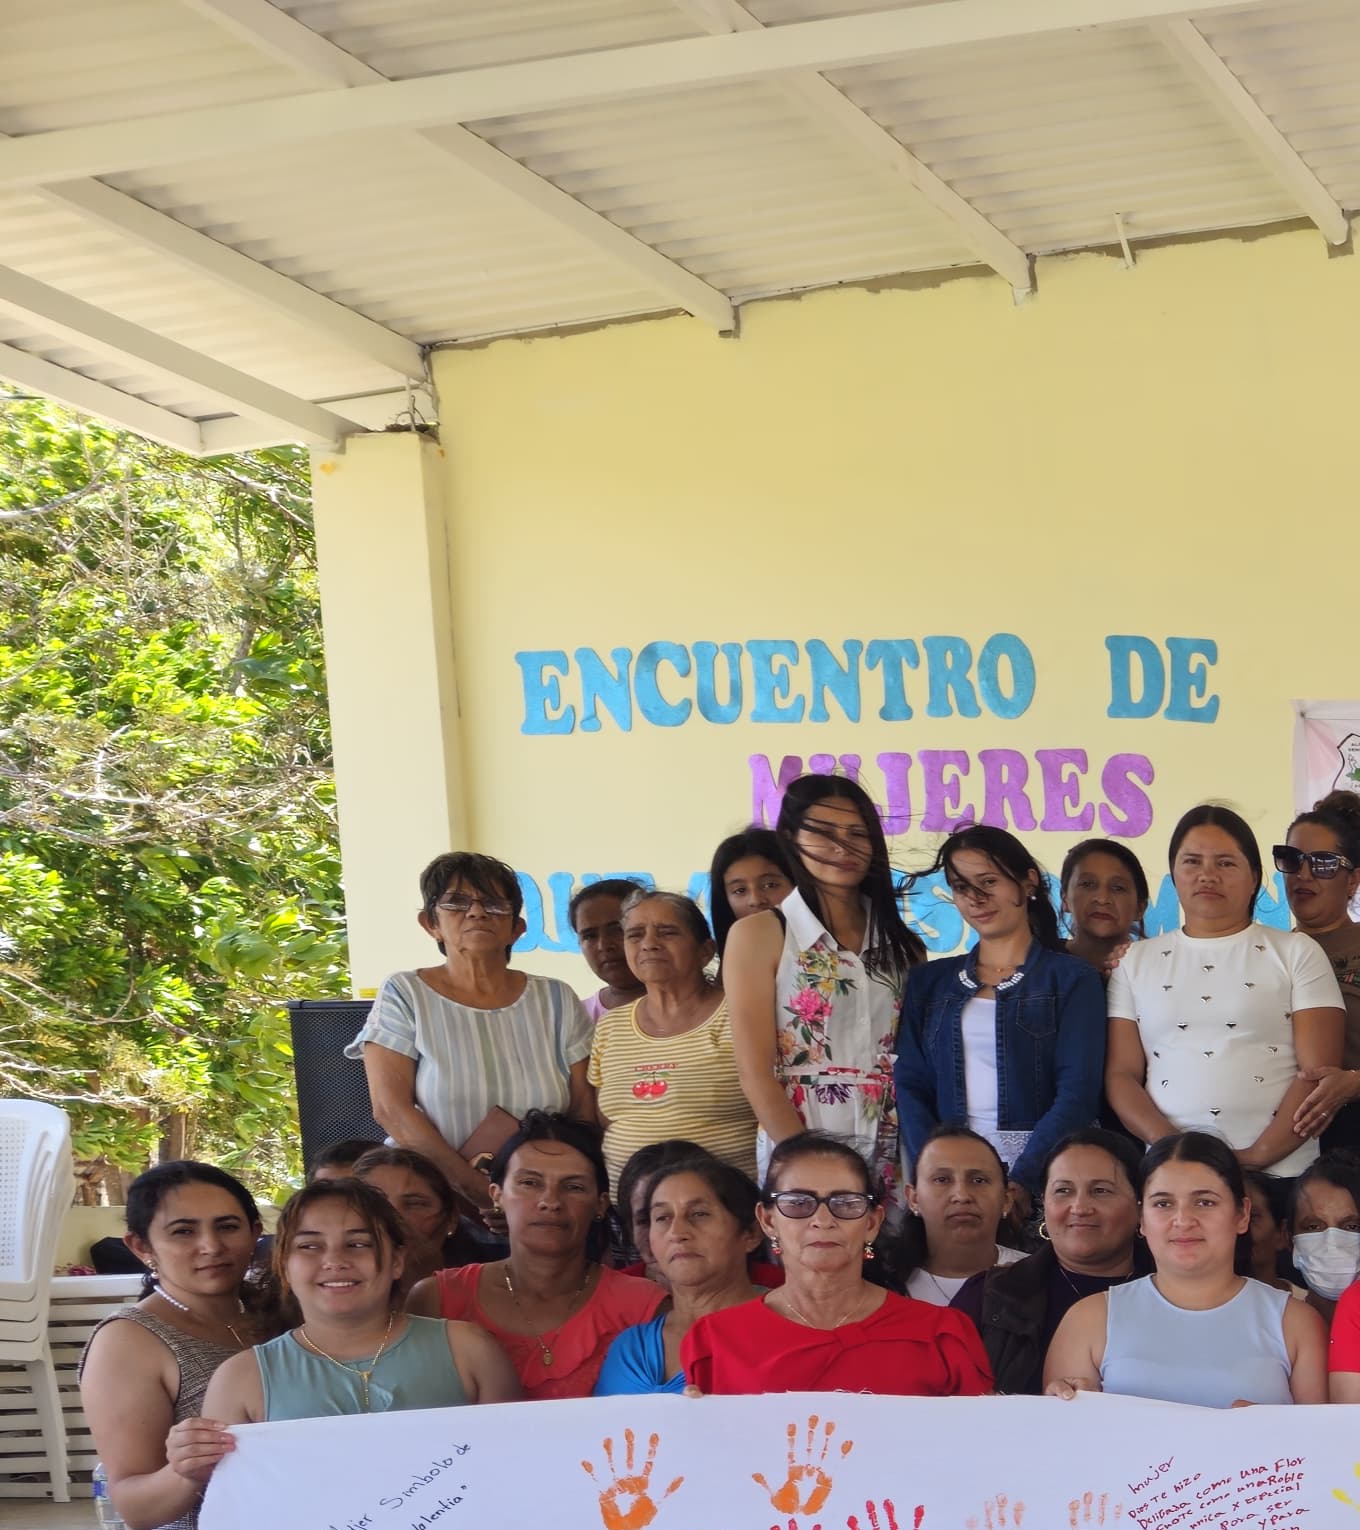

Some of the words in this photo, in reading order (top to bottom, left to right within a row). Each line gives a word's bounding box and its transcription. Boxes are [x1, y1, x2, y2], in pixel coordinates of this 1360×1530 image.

[514, 633, 1036, 735] ENCUENTRO
[1105, 635, 1220, 724] DE
[749, 748, 1155, 838] MJERES
[452, 1444, 471, 1456] de
[1173, 1472, 1202, 1493] hizo
[1195, 1477, 1232, 1500] como
[1274, 1456, 1307, 1473] Flor
